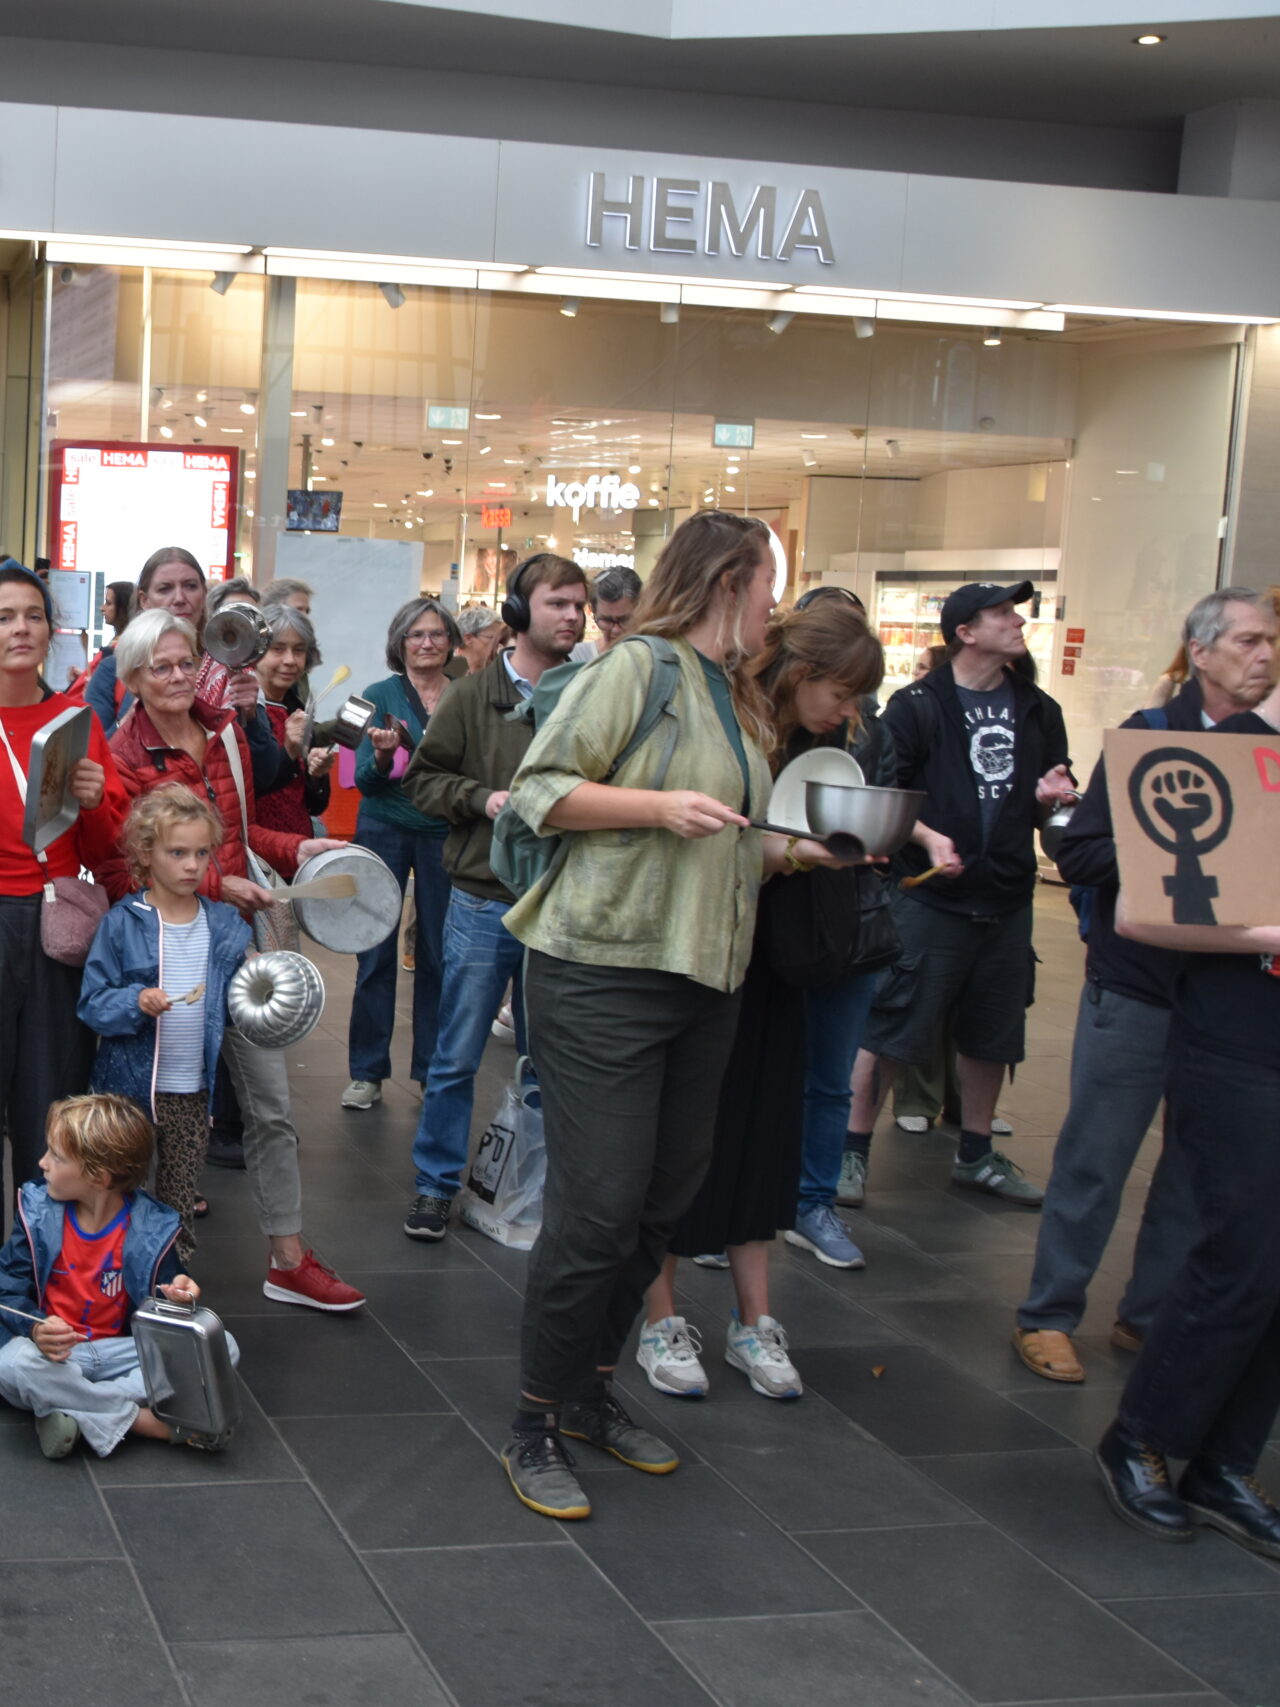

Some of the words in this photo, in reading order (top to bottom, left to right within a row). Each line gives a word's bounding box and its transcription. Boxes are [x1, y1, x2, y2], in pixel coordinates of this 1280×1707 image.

[586, 171, 835, 265] HEMA
[70, 452, 96, 464] sale
[103, 452, 146, 466] HEMA
[186, 455, 228, 470] HEMA
[213, 483, 227, 527] HEMA
[546, 474, 640, 522] koffie
[481, 503, 512, 528] kassa
[62, 524, 76, 567] HEMA
